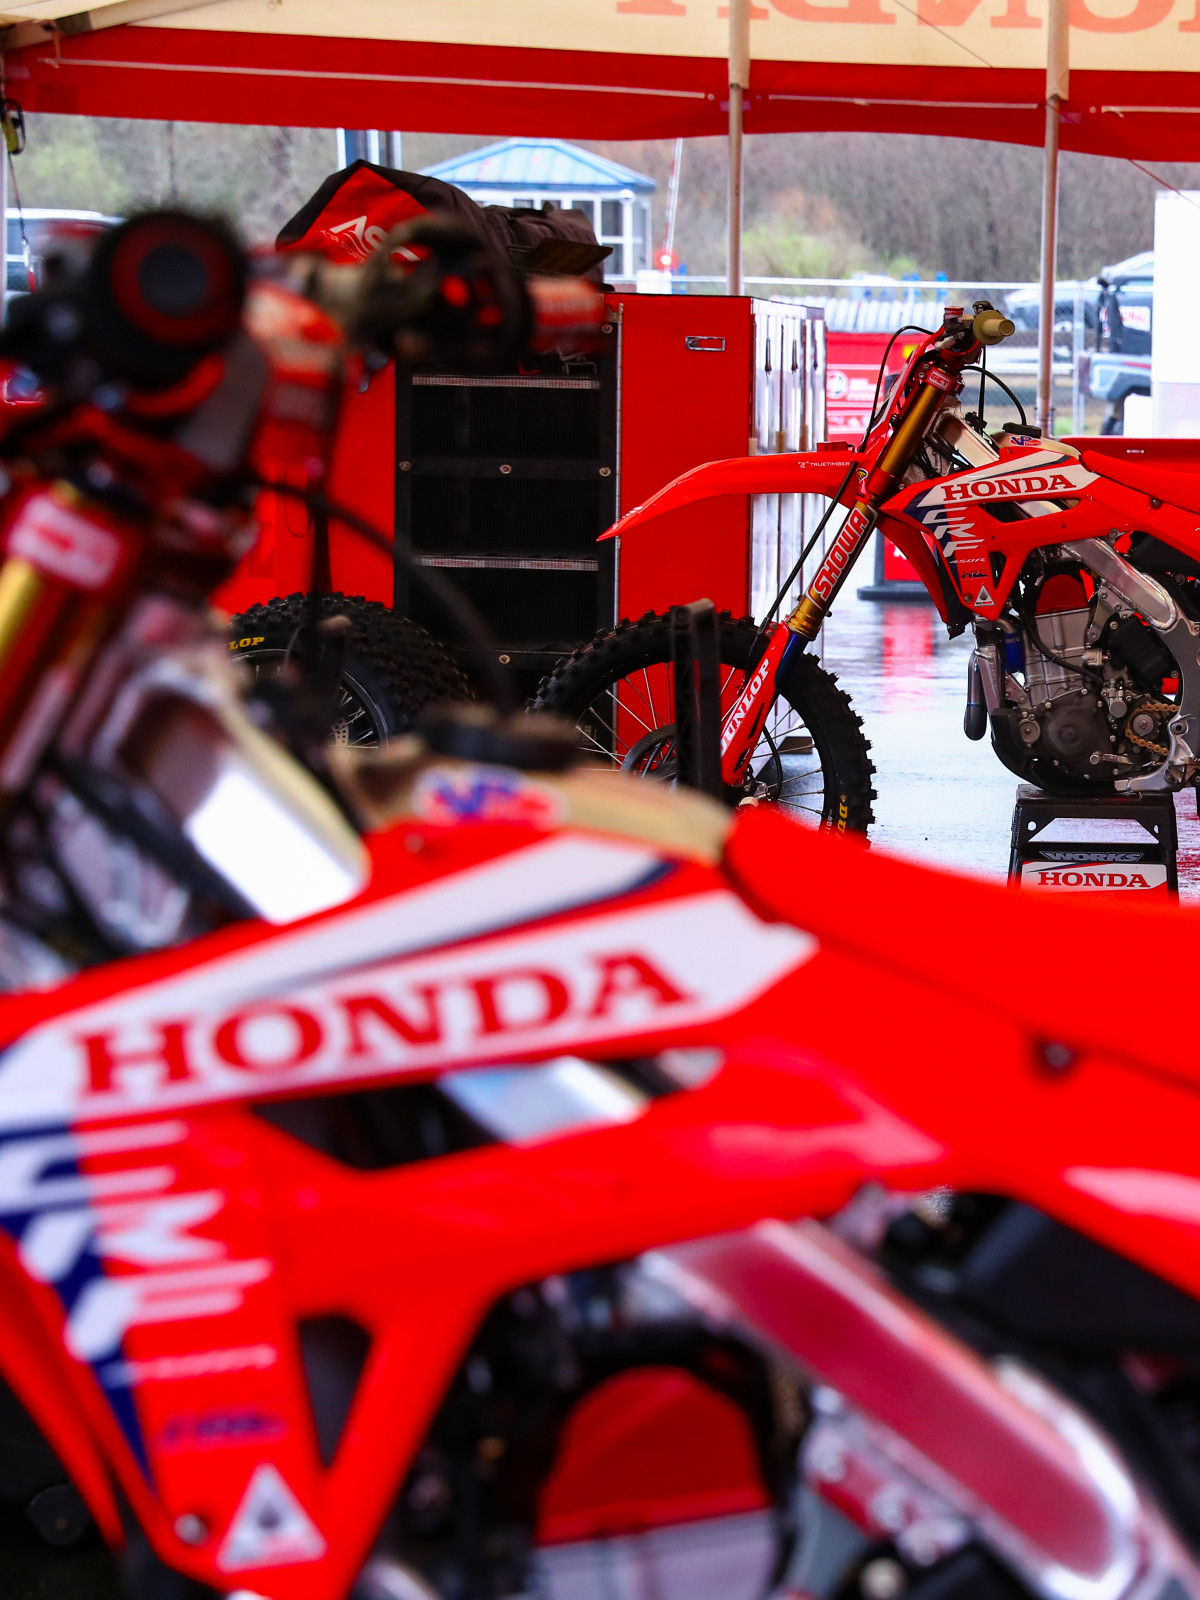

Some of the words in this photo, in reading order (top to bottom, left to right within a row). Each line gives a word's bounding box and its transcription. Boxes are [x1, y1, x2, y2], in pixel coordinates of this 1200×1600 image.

[941, 474, 1076, 502] HONDA
[922, 506, 986, 558] CRF
[813, 508, 870, 602] SHOWA
[1045, 851, 1140, 862] WORKS
[1038, 872, 1151, 888] HONDA
[74, 948, 698, 1098] HONDA
